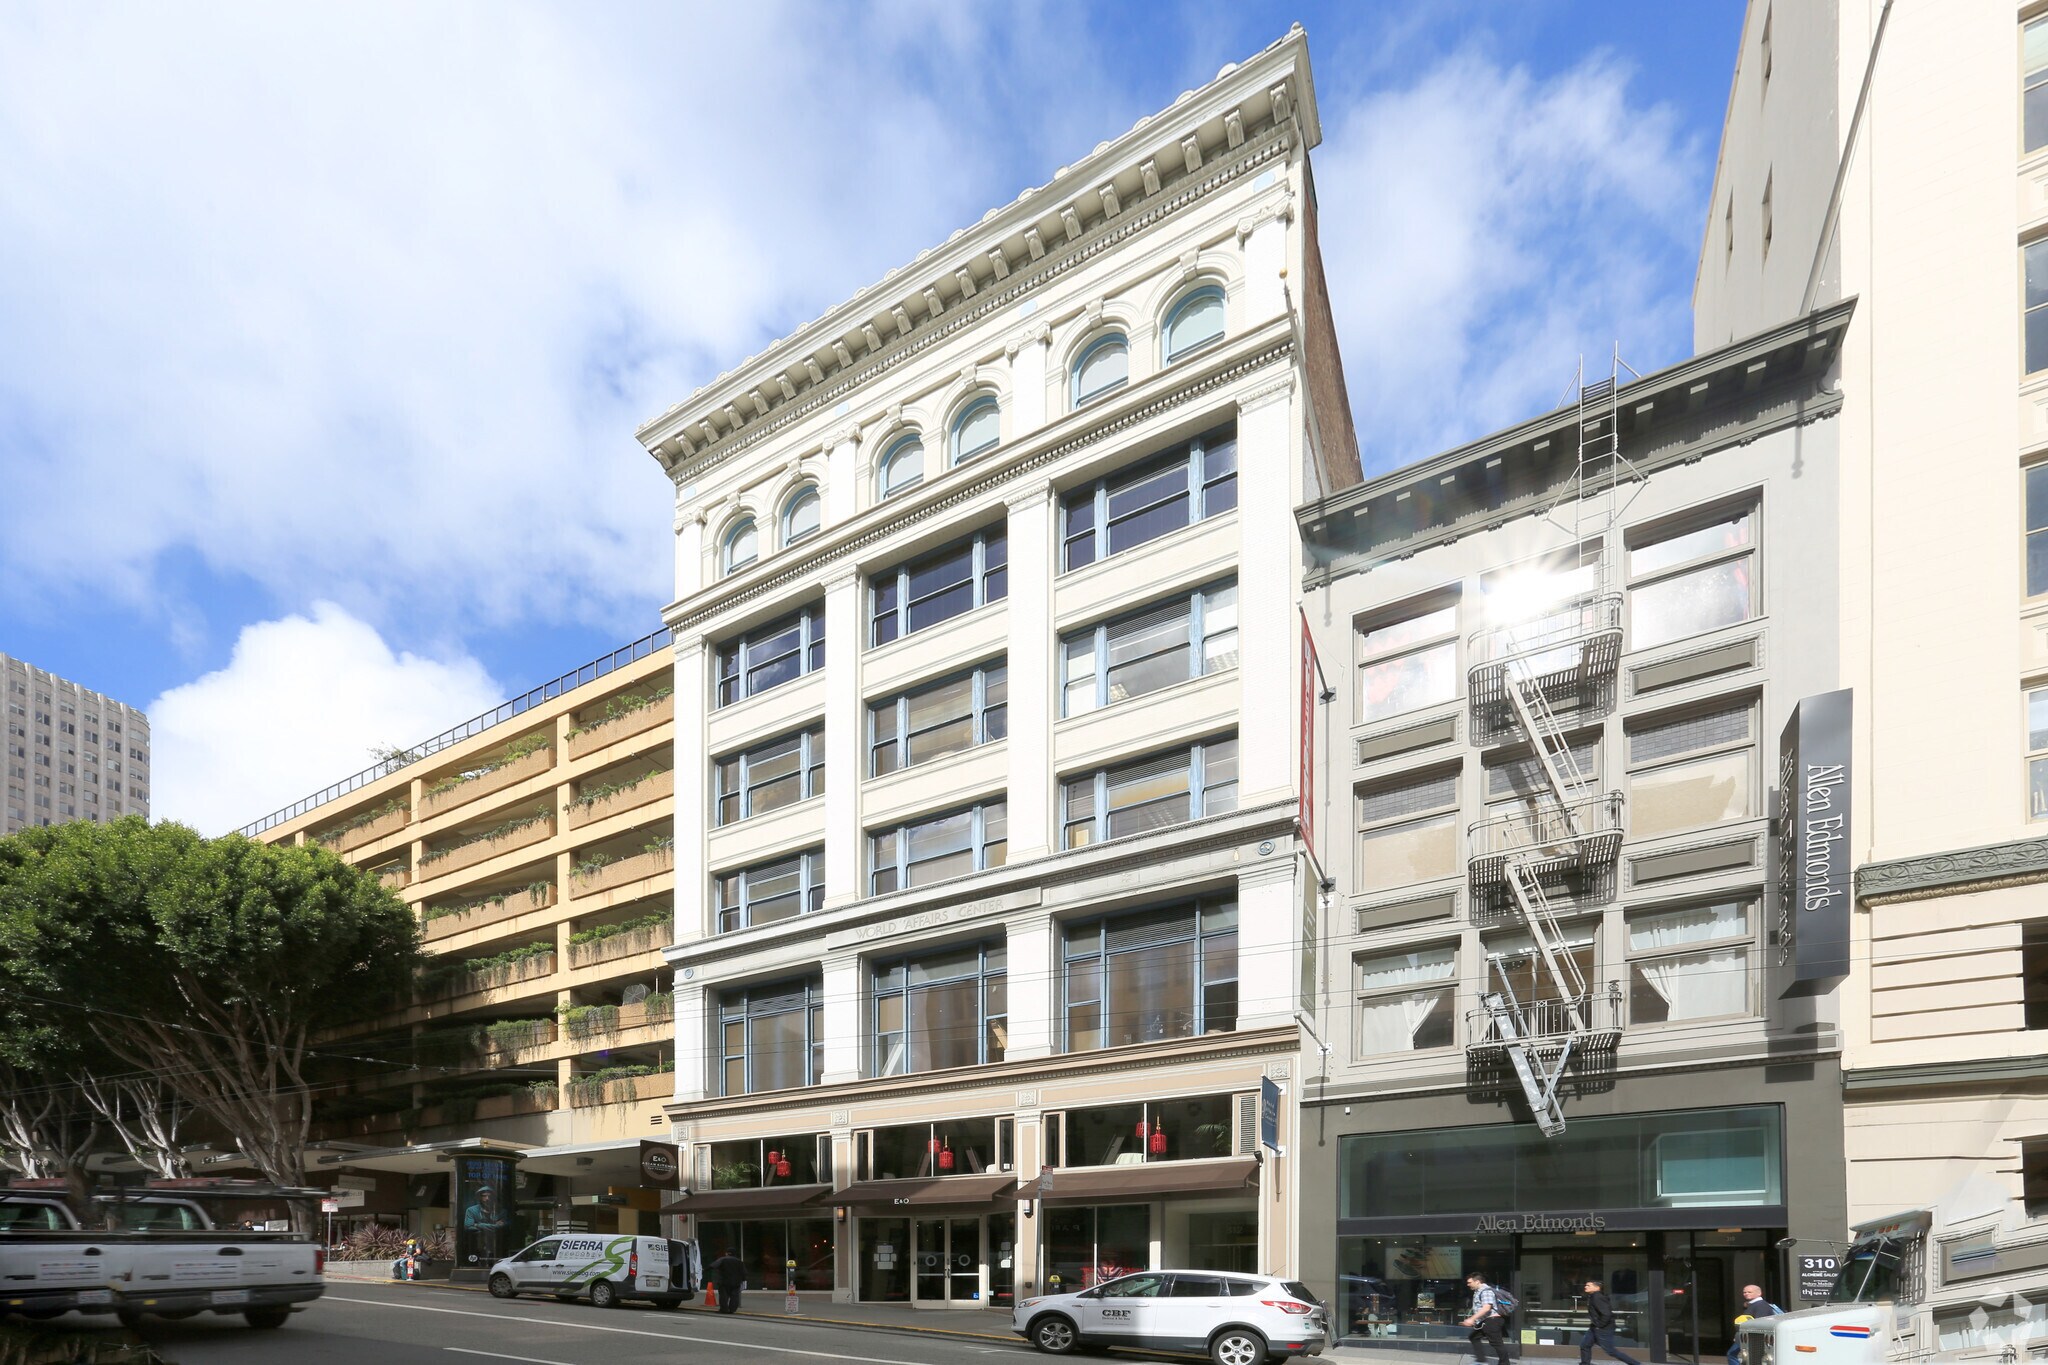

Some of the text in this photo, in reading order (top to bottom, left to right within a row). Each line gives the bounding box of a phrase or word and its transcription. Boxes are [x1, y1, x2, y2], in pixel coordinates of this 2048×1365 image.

[1804, 764, 1845, 912] Allen Edmonds
[855, 899, 1004, 940] WORLD AFFAIRS CENTER
[1475, 1212, 1606, 1231] Allen Edmonds
[561, 1240, 603, 1251] SIERRA
[1804, 1258, 1835, 1269] 310
